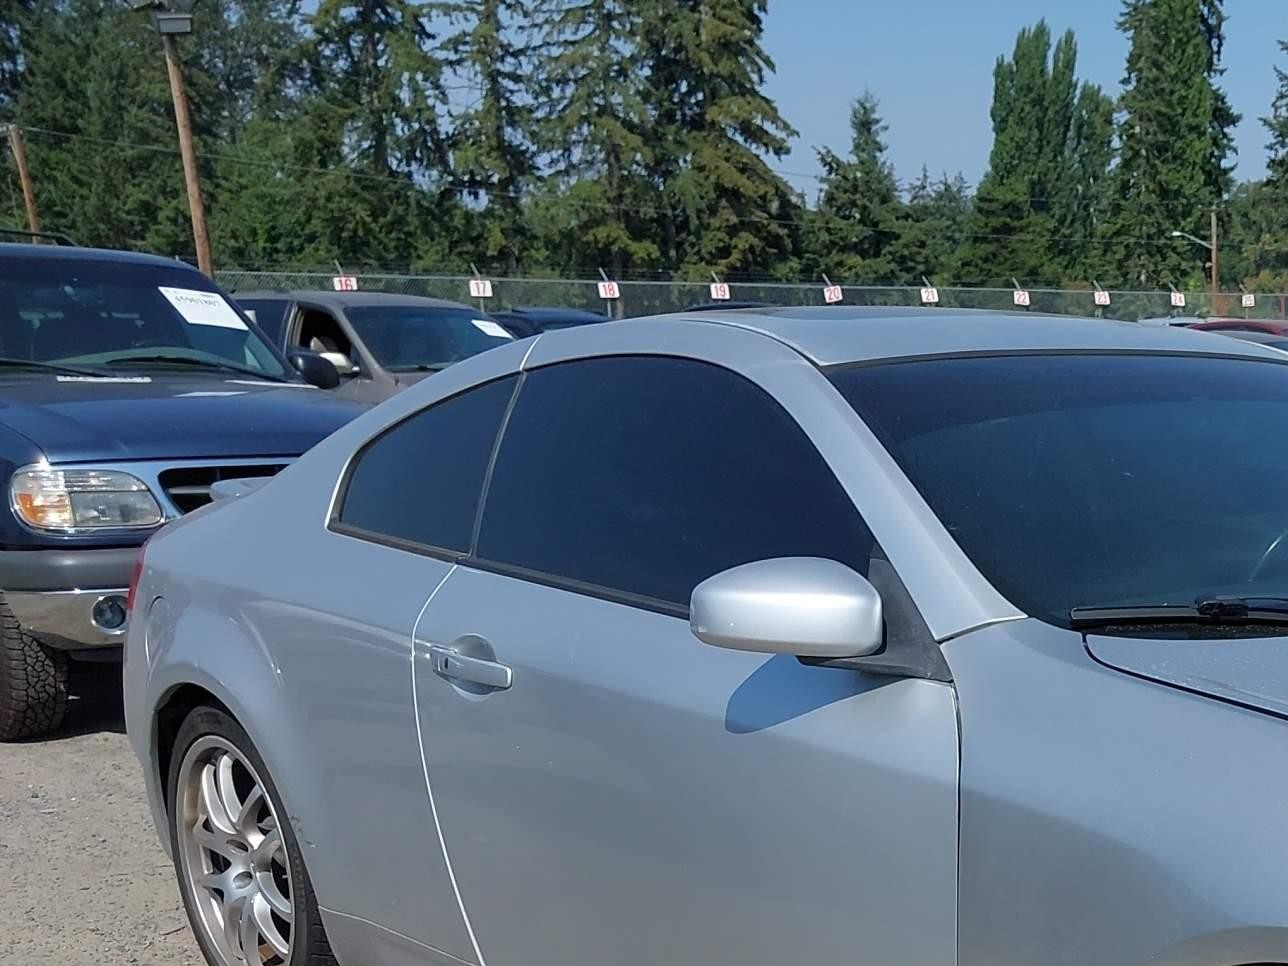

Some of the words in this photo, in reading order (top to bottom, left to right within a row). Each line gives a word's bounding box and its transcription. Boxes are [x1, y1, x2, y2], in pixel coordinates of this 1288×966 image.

[338, 279, 352, 290] 16
[475, 281, 486, 294] 17
[602, 284, 615, 296] 18
[714, 284, 726, 297] 19
[827, 287, 840, 300] 20
[924, 289, 936, 301] 21
[1016, 292, 1027, 304] 22
[1097, 292, 1108, 304] 23
[1172, 294, 1183, 305] 24
